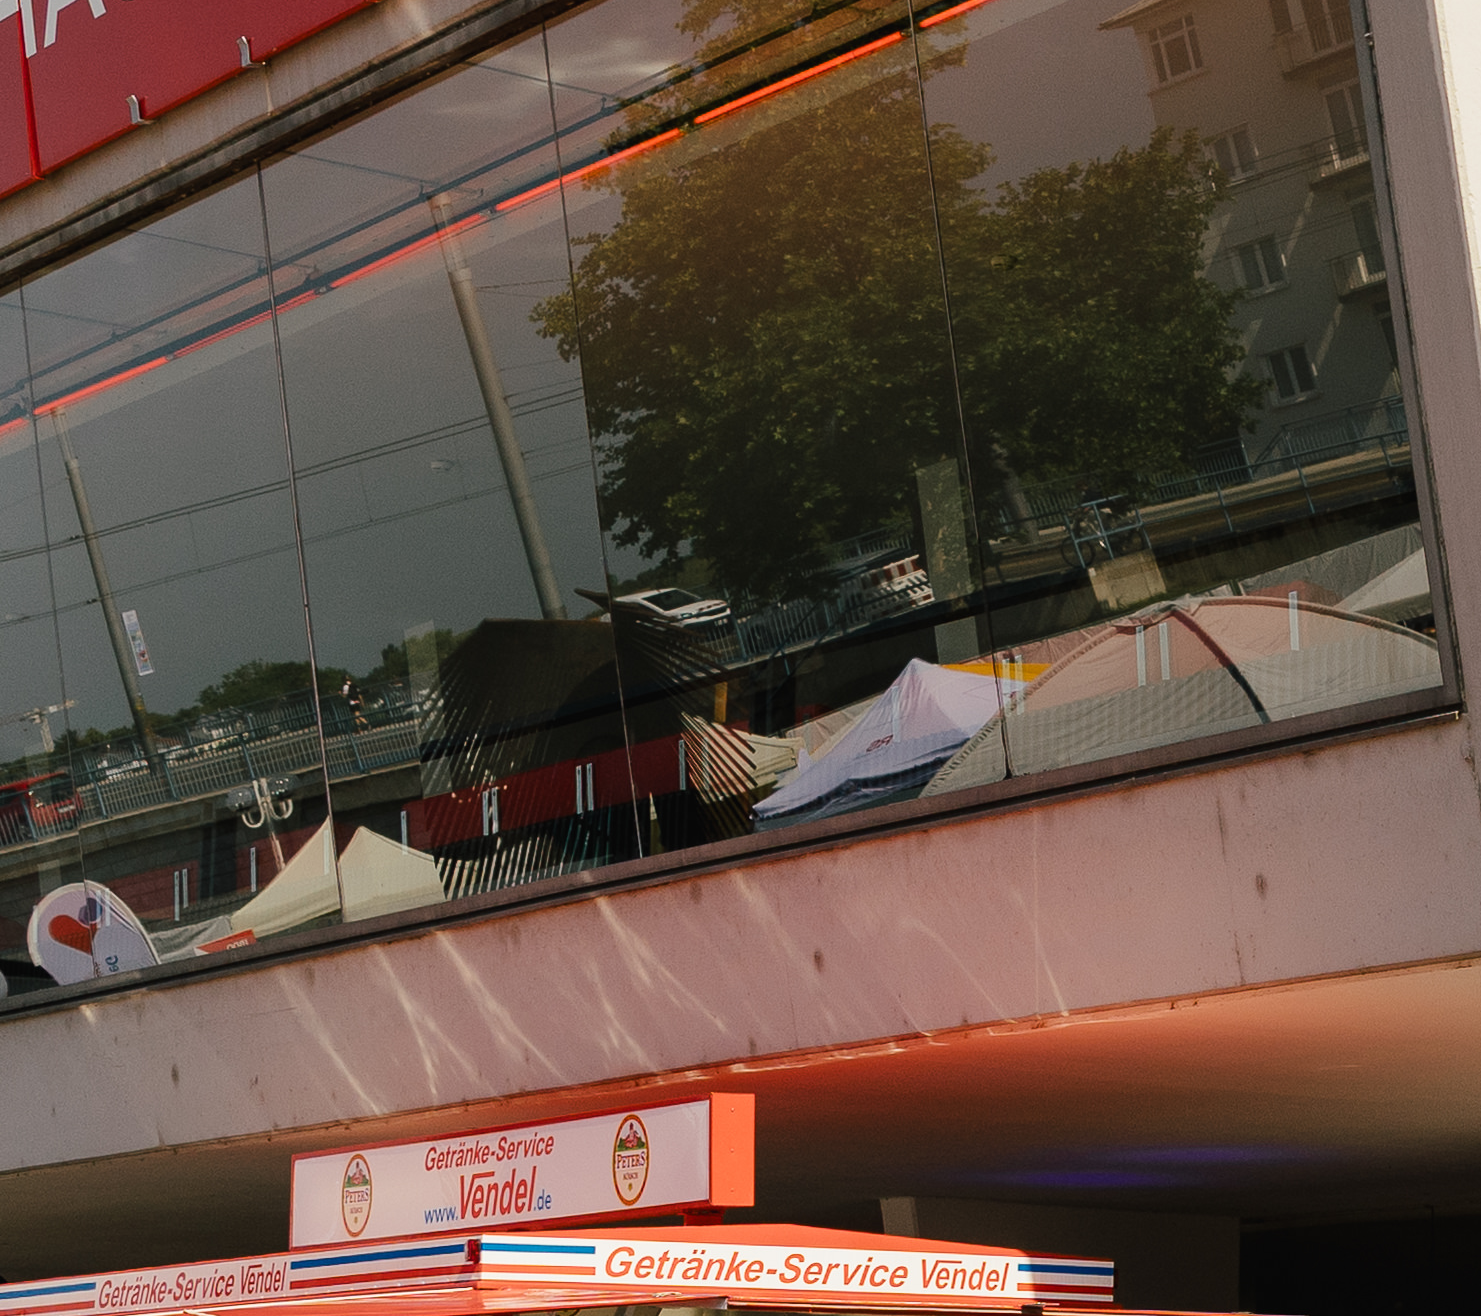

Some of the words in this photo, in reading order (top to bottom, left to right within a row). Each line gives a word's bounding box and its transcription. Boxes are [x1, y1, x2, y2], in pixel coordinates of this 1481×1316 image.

[424, 1132, 555, 1172] Getränke-Service
[424, 1165, 553, 1225] www.Vendel.de
[98, 1268, 236, 1310] Getränke-Service
[240, 1261, 288, 1296] Vendel
[604, 1245, 910, 1289] Getränke-Service
[920, 1258, 1010, 1292] Vendel
